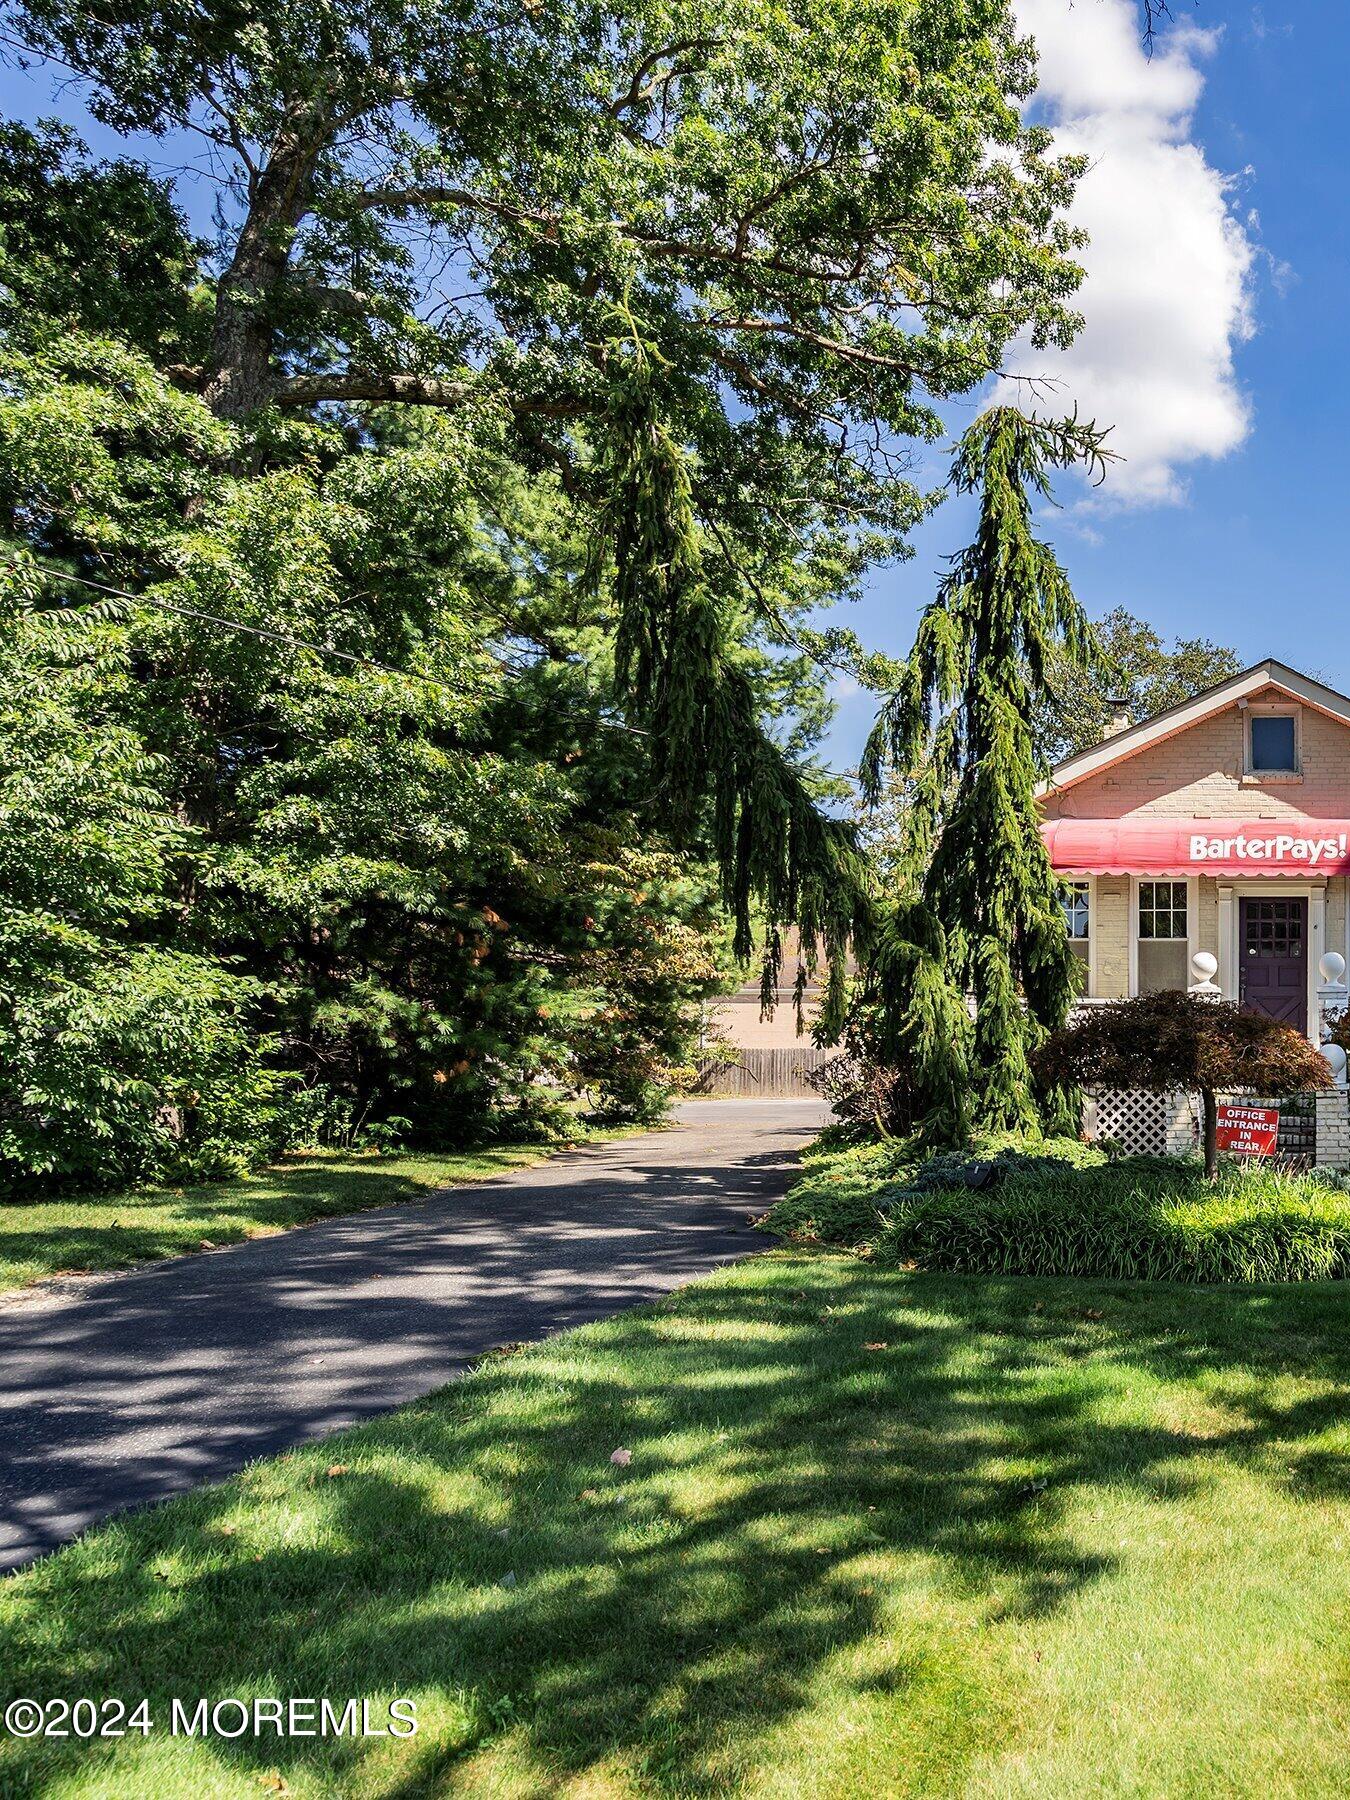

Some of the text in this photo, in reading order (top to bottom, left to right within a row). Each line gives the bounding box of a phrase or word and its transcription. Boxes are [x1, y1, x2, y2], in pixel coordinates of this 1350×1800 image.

[1190, 835, 1347, 864] BarterPays!
[1227, 1109, 1266, 1120] OFFICE
[1218, 1119, 1276, 1132] ENTRANCE
[1240, 1131, 1251, 1140] IN
[1230, 1141, 1260, 1151] REAR
